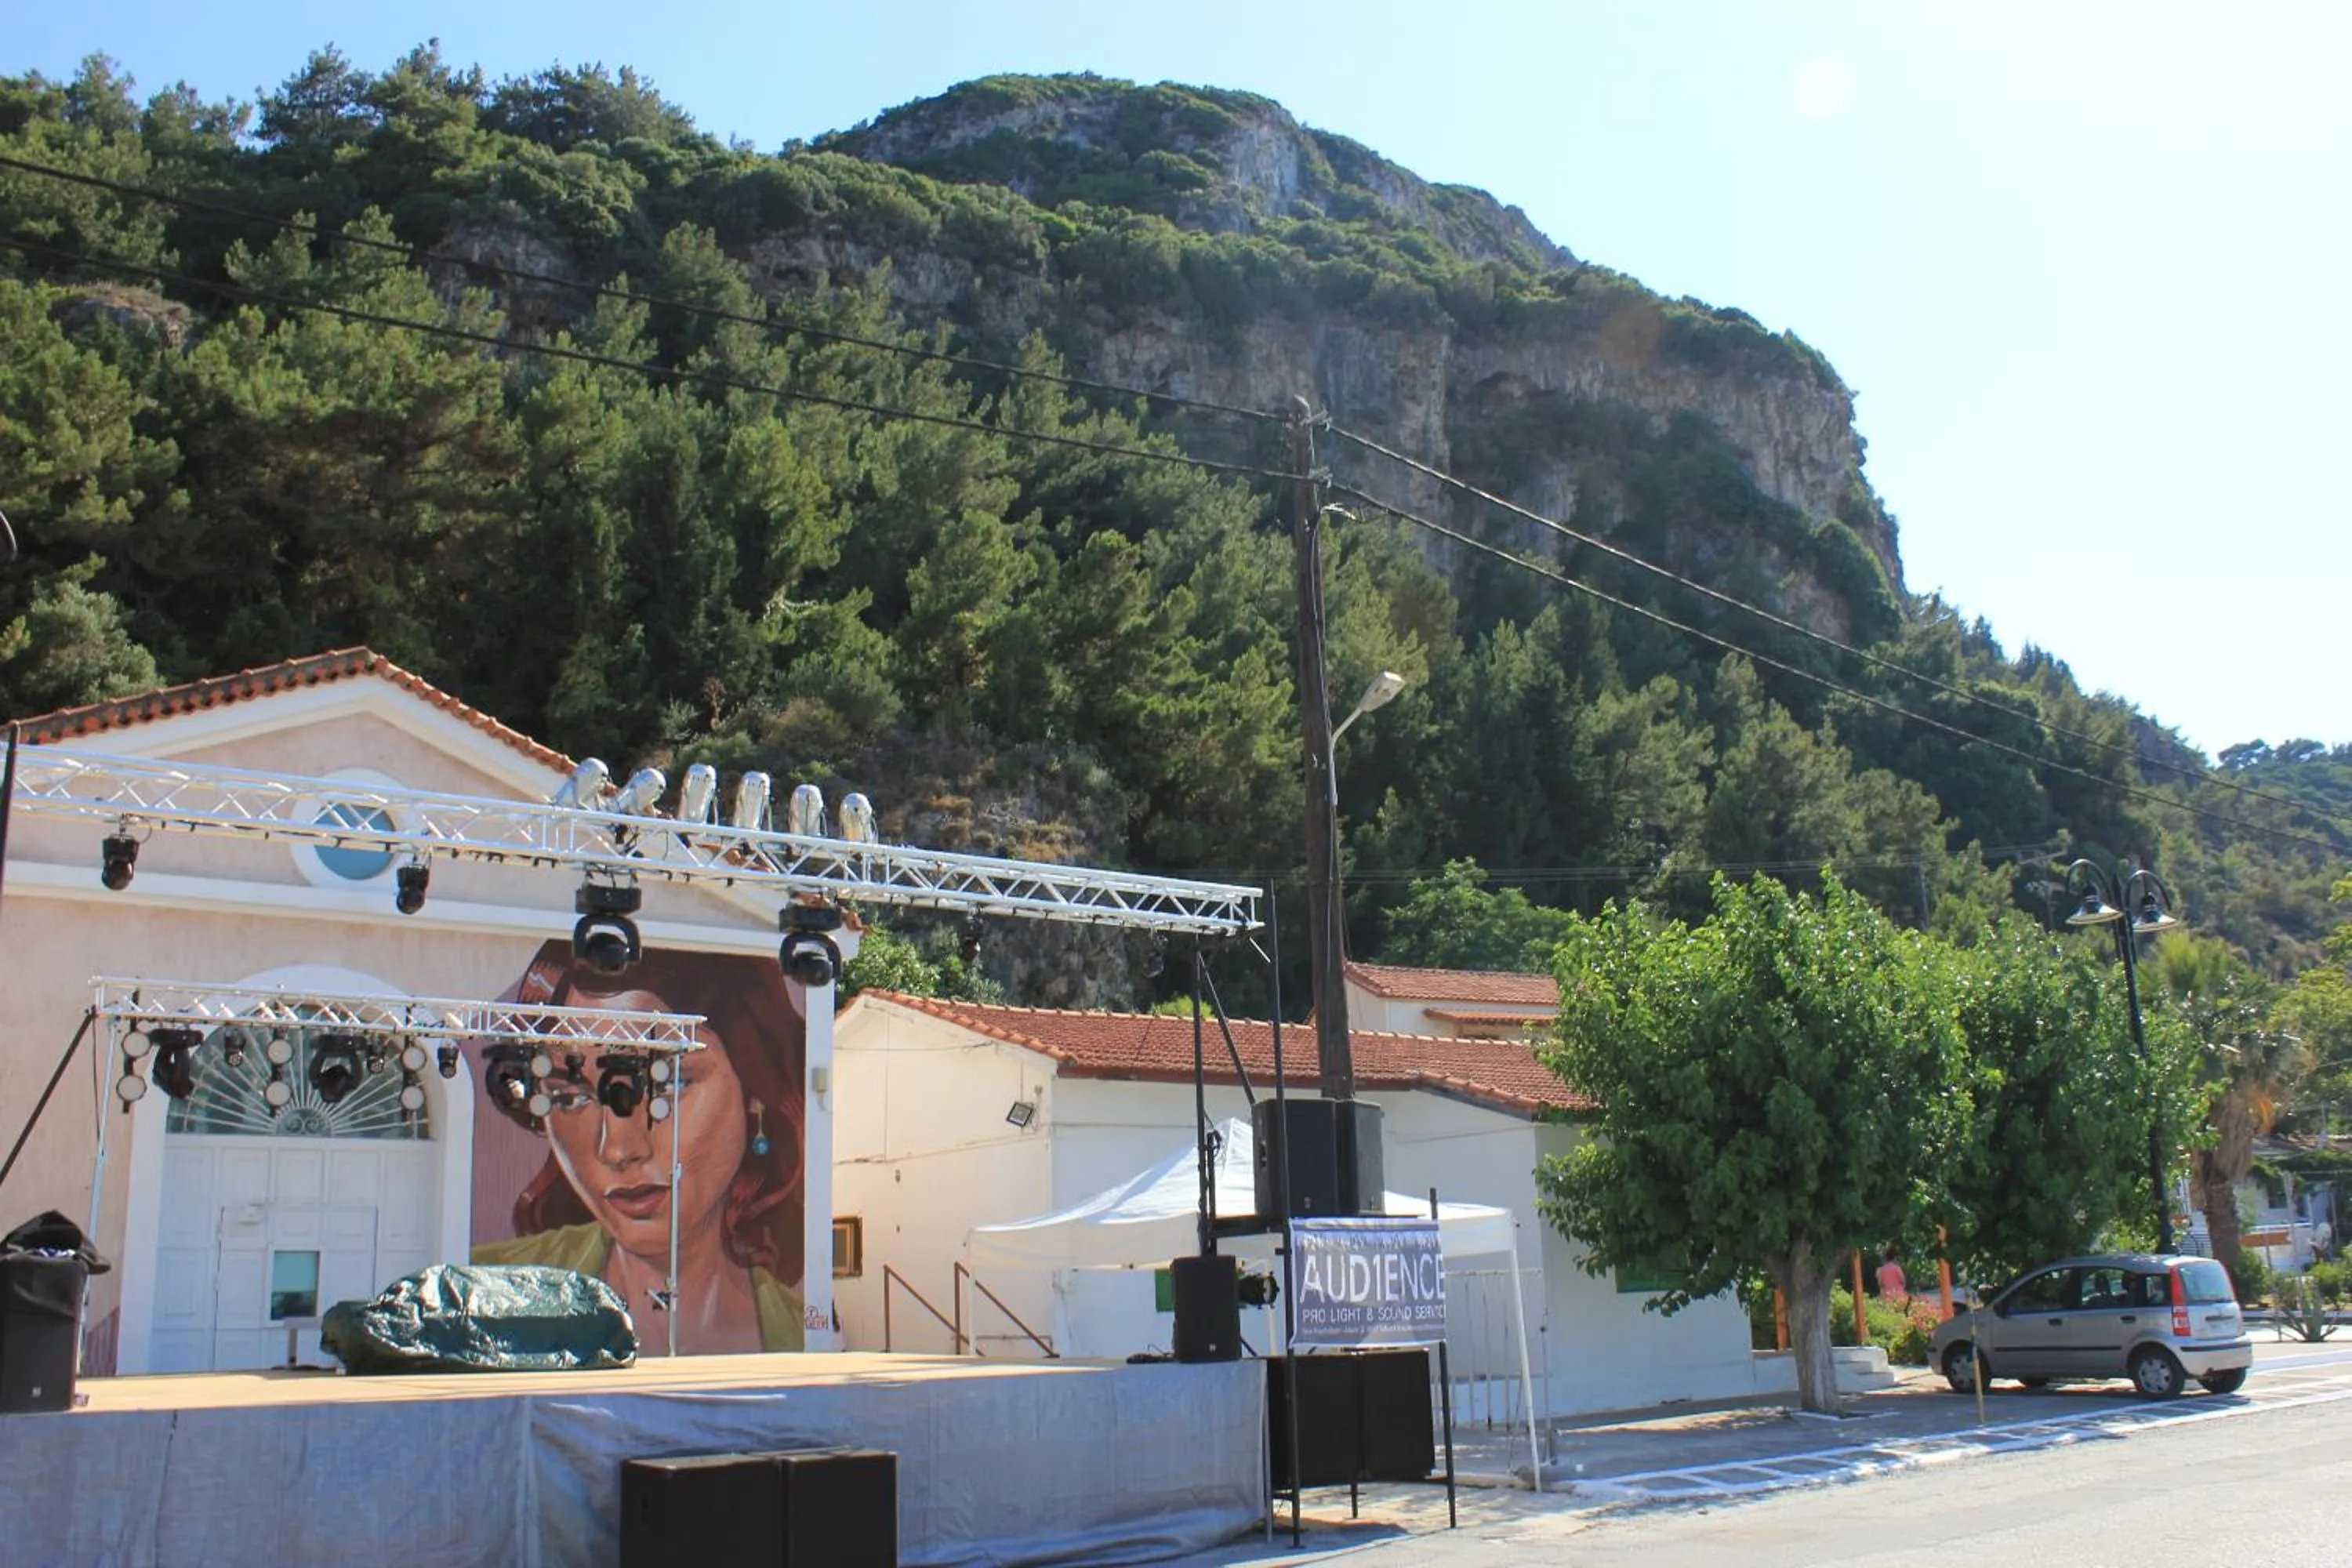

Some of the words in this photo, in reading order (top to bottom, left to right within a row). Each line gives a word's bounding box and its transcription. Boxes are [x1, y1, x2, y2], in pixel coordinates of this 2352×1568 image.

[1330, 1307, 1361, 1323] LIGHT
[1367, 1307, 1374, 1322] &
[1377, 1305, 1412, 1321] SOUND
